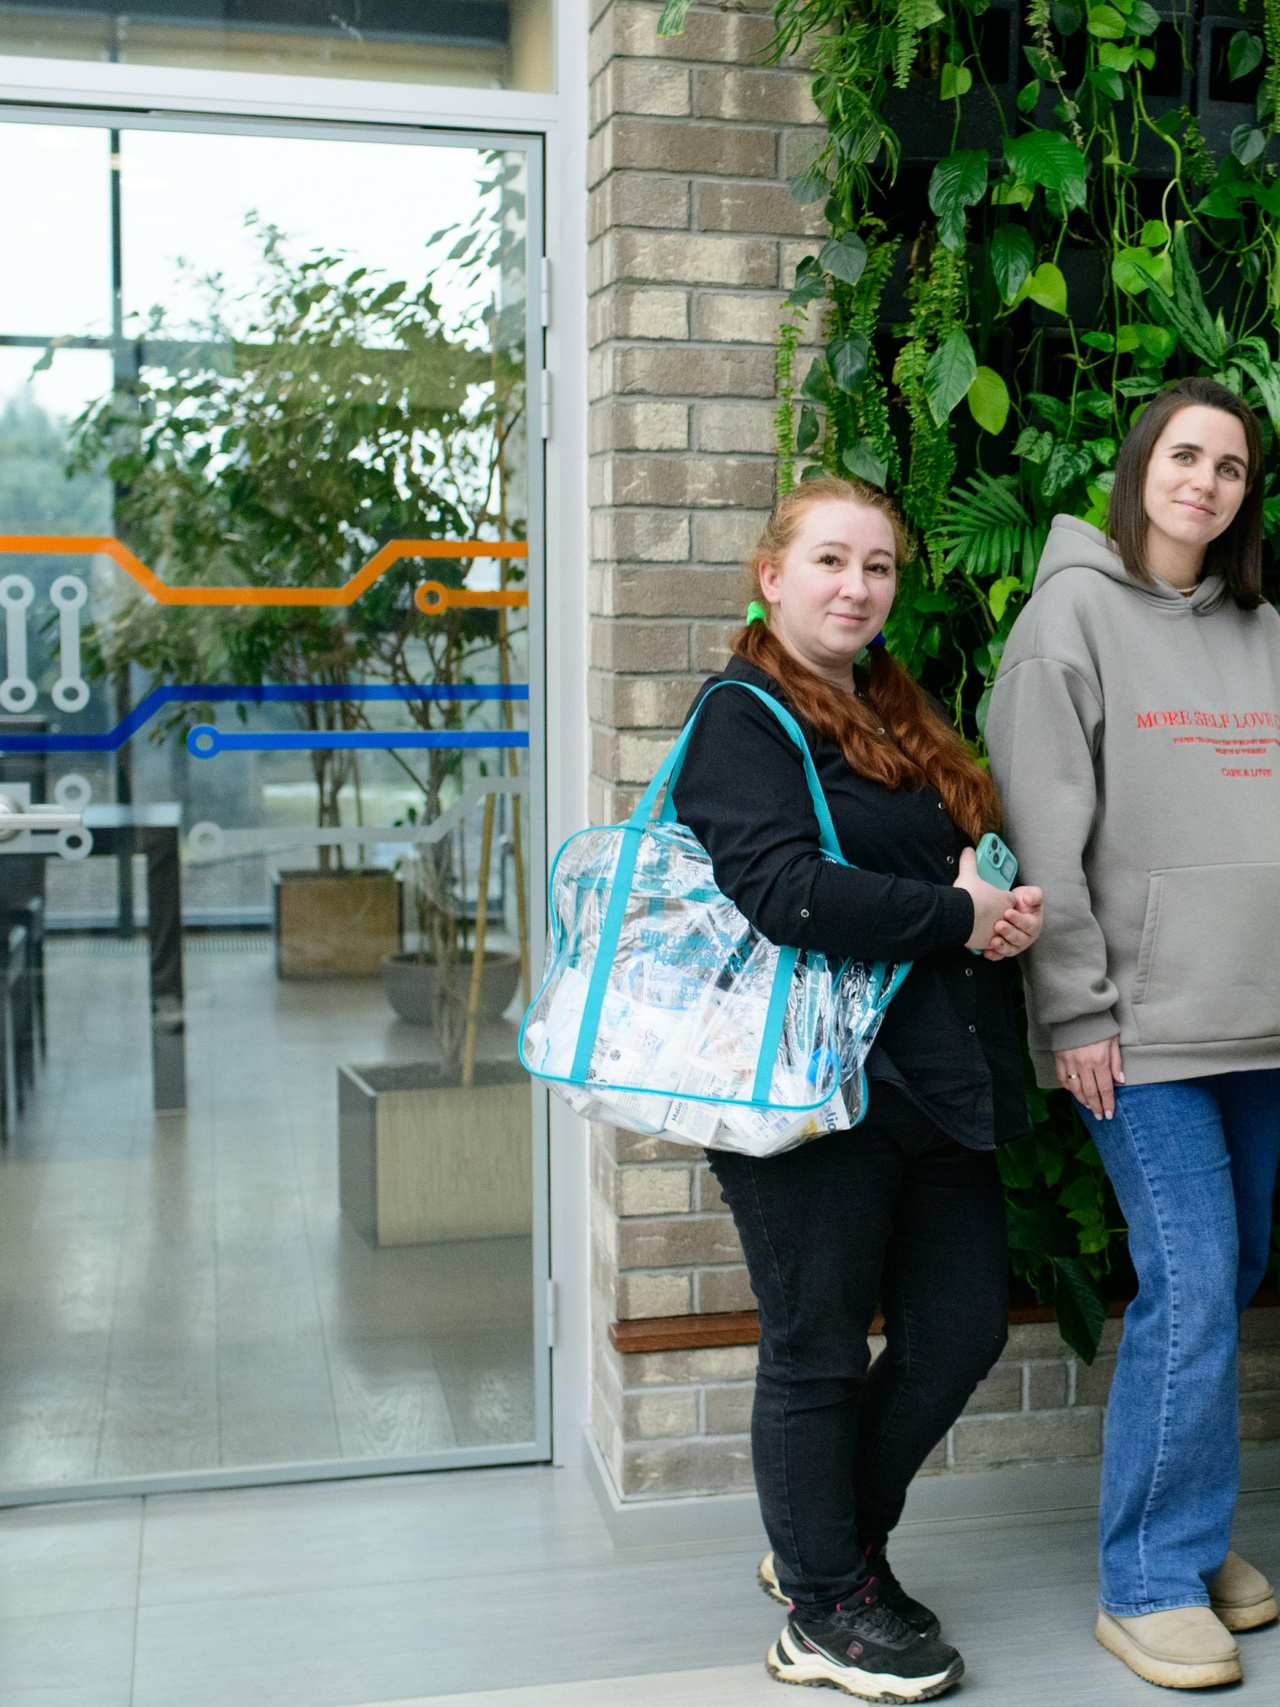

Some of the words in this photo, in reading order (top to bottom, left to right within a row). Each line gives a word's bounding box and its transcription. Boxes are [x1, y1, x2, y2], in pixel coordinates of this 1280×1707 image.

[1135, 710, 1192, 729] MORE
[1194, 711, 1230, 729] SELF
[1232, 712, 1273, 729] LOVE
[1221, 767, 1242, 778] CARE
[1250, 767, 1273, 778] LOVE
